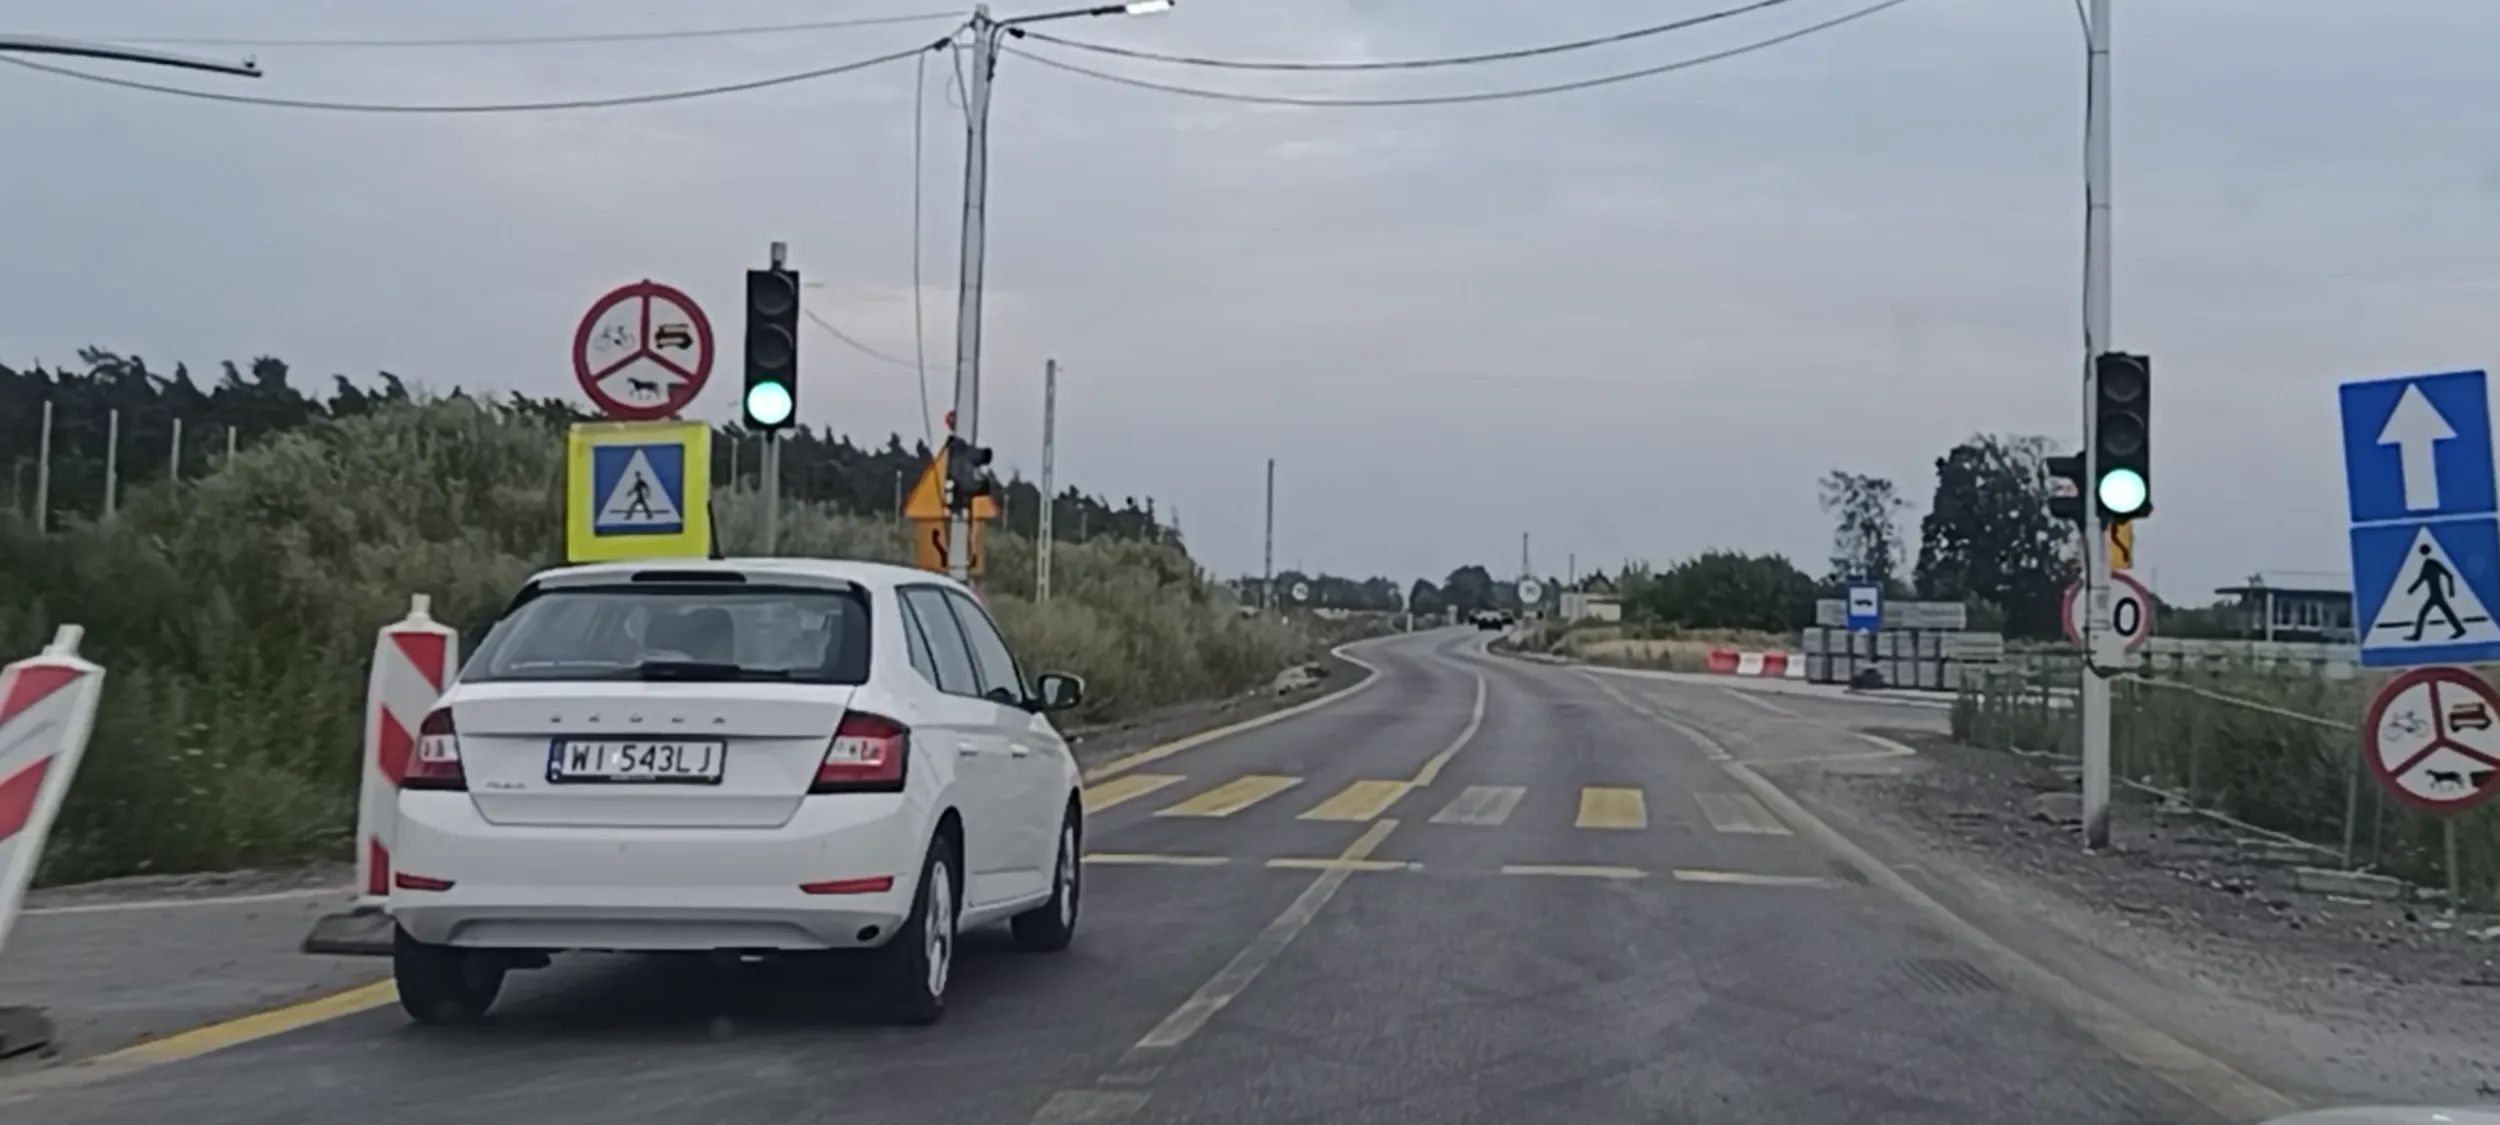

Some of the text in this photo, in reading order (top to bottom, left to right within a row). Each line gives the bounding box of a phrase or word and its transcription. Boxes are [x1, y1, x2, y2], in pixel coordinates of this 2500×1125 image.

[2114, 597, 2140, 637] 0
[571, 745, 711, 772] WI 543LJ
